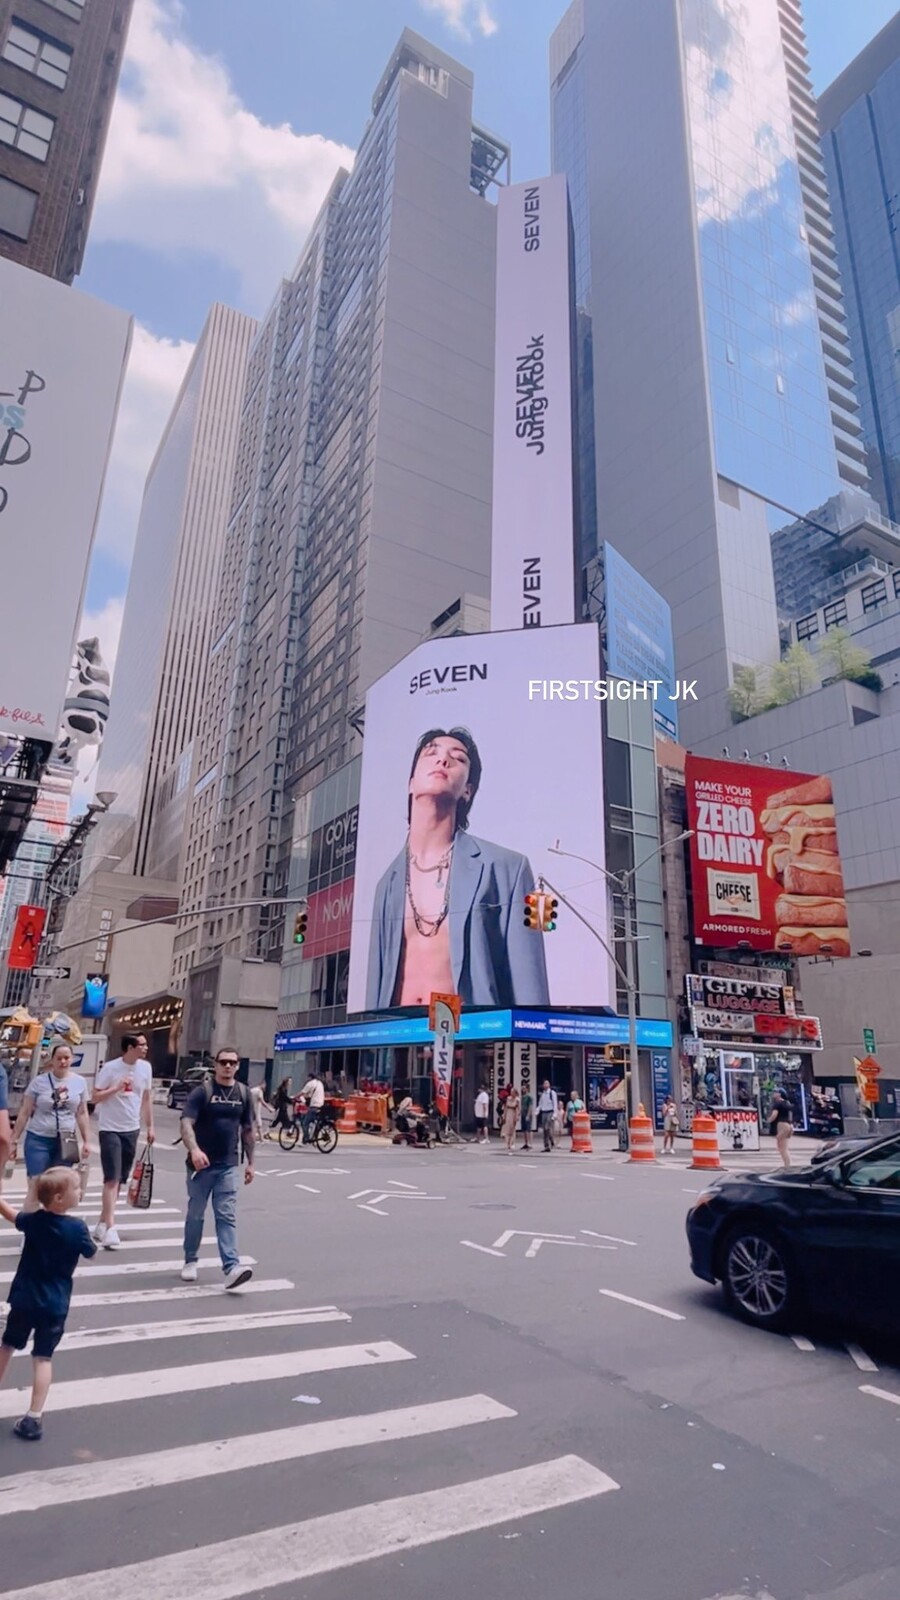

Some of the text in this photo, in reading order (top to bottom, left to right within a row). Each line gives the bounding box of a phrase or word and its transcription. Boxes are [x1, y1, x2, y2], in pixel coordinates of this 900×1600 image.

[525, 186, 539, 251] SEVEN
[516, 354, 533, 439] SEVEN
[526, 334, 548, 456] Jung Kook
[523, 556, 541, 629] EVEN
[409, 663, 488, 694] SEVEN
[694, 780, 752, 797] MAKE YOUR
[695, 791, 752, 806] GRILLED CHEESE
[695, 800, 755, 837] ZERO
[697, 831, 764, 867] DAIRY
[716, 882, 752, 903] CHEESE
[702, 923, 772, 936] ARMORED FRESH
[705, 979, 781, 999] GIFTS
[707, 993, 781, 1013] LUGGAGE
[713, 1110, 758, 1123] CHICAGO
